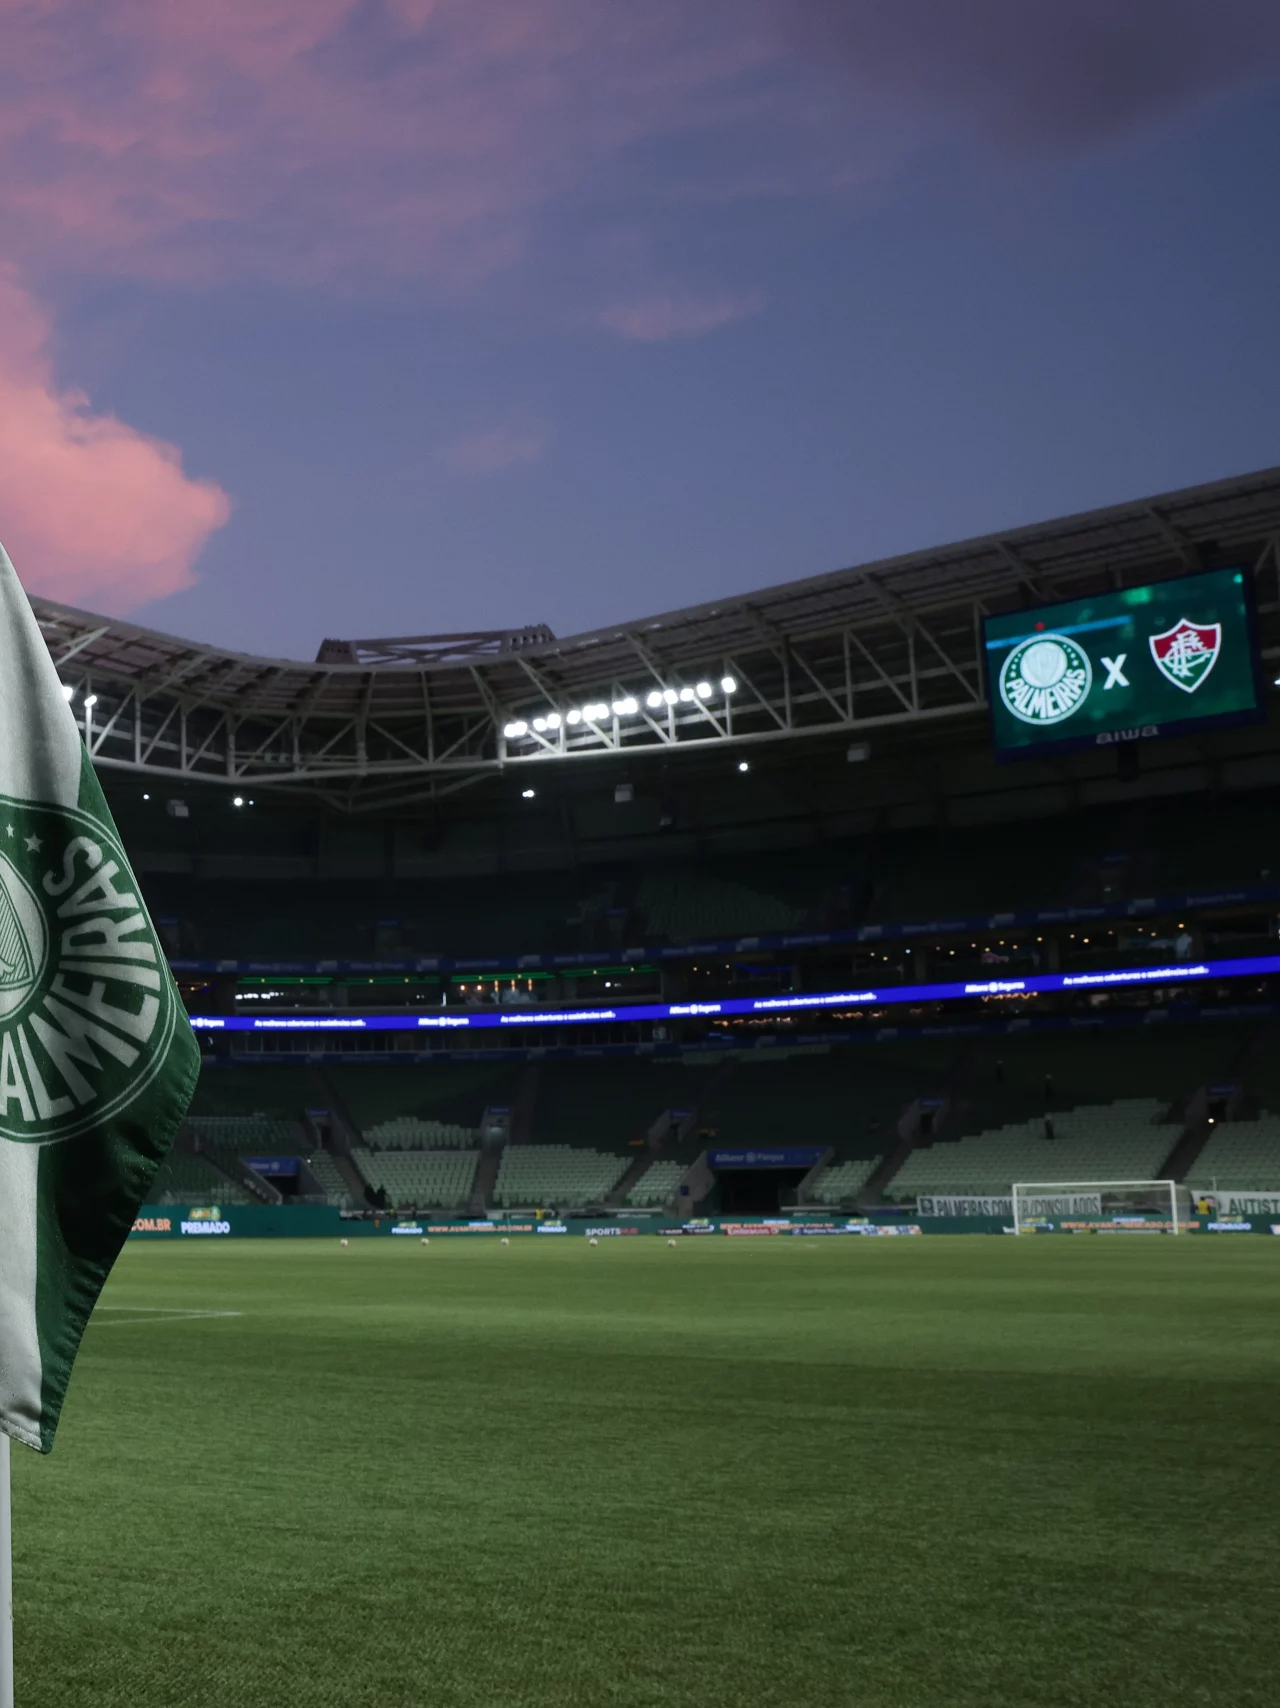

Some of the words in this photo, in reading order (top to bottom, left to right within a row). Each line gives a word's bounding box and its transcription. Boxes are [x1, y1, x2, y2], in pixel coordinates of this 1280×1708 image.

[1005, 668, 1086, 719] PALMEIRAS
[1095, 725, 1160, 745] aiwa
[181, 1221, 230, 1234] PREMIADO
